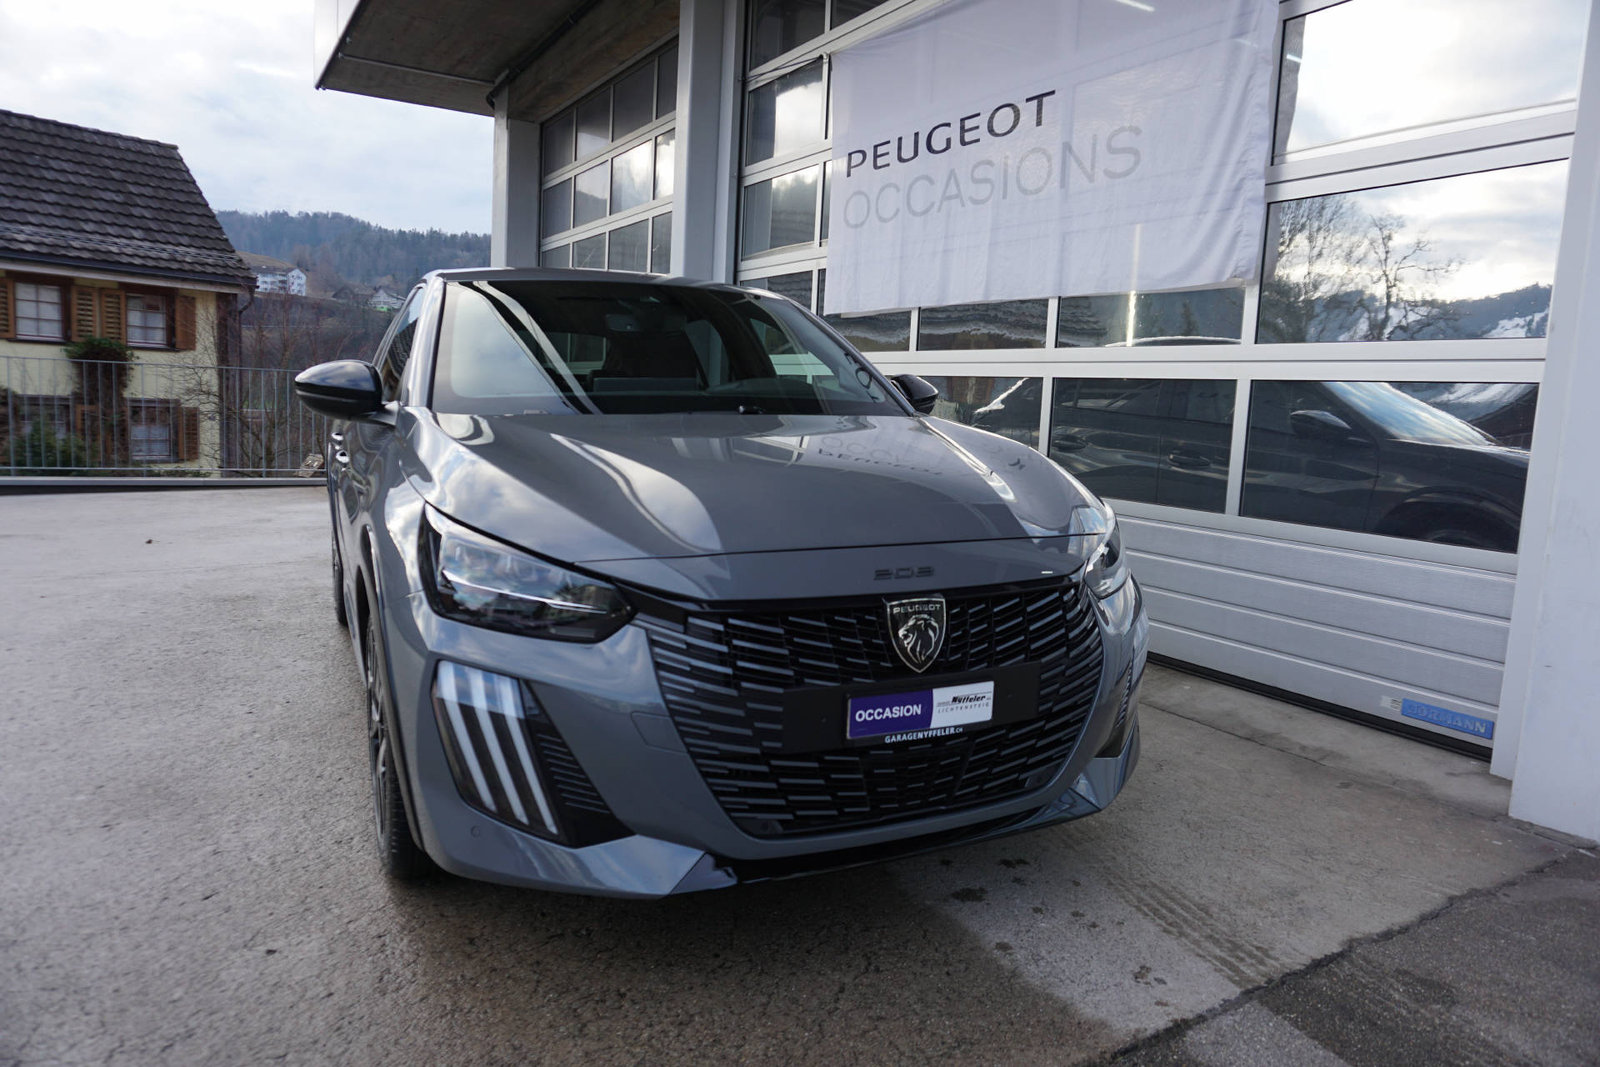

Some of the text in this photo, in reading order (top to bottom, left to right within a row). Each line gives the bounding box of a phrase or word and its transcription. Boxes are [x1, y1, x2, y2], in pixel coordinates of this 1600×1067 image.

[846, 89, 1056, 178] PEUGEOT
[843, 125, 1144, 230] OCCASIONS
[855, 704, 922, 723] OCCASION
[884, 728, 963, 743] GARAGENYFFELER.CH
